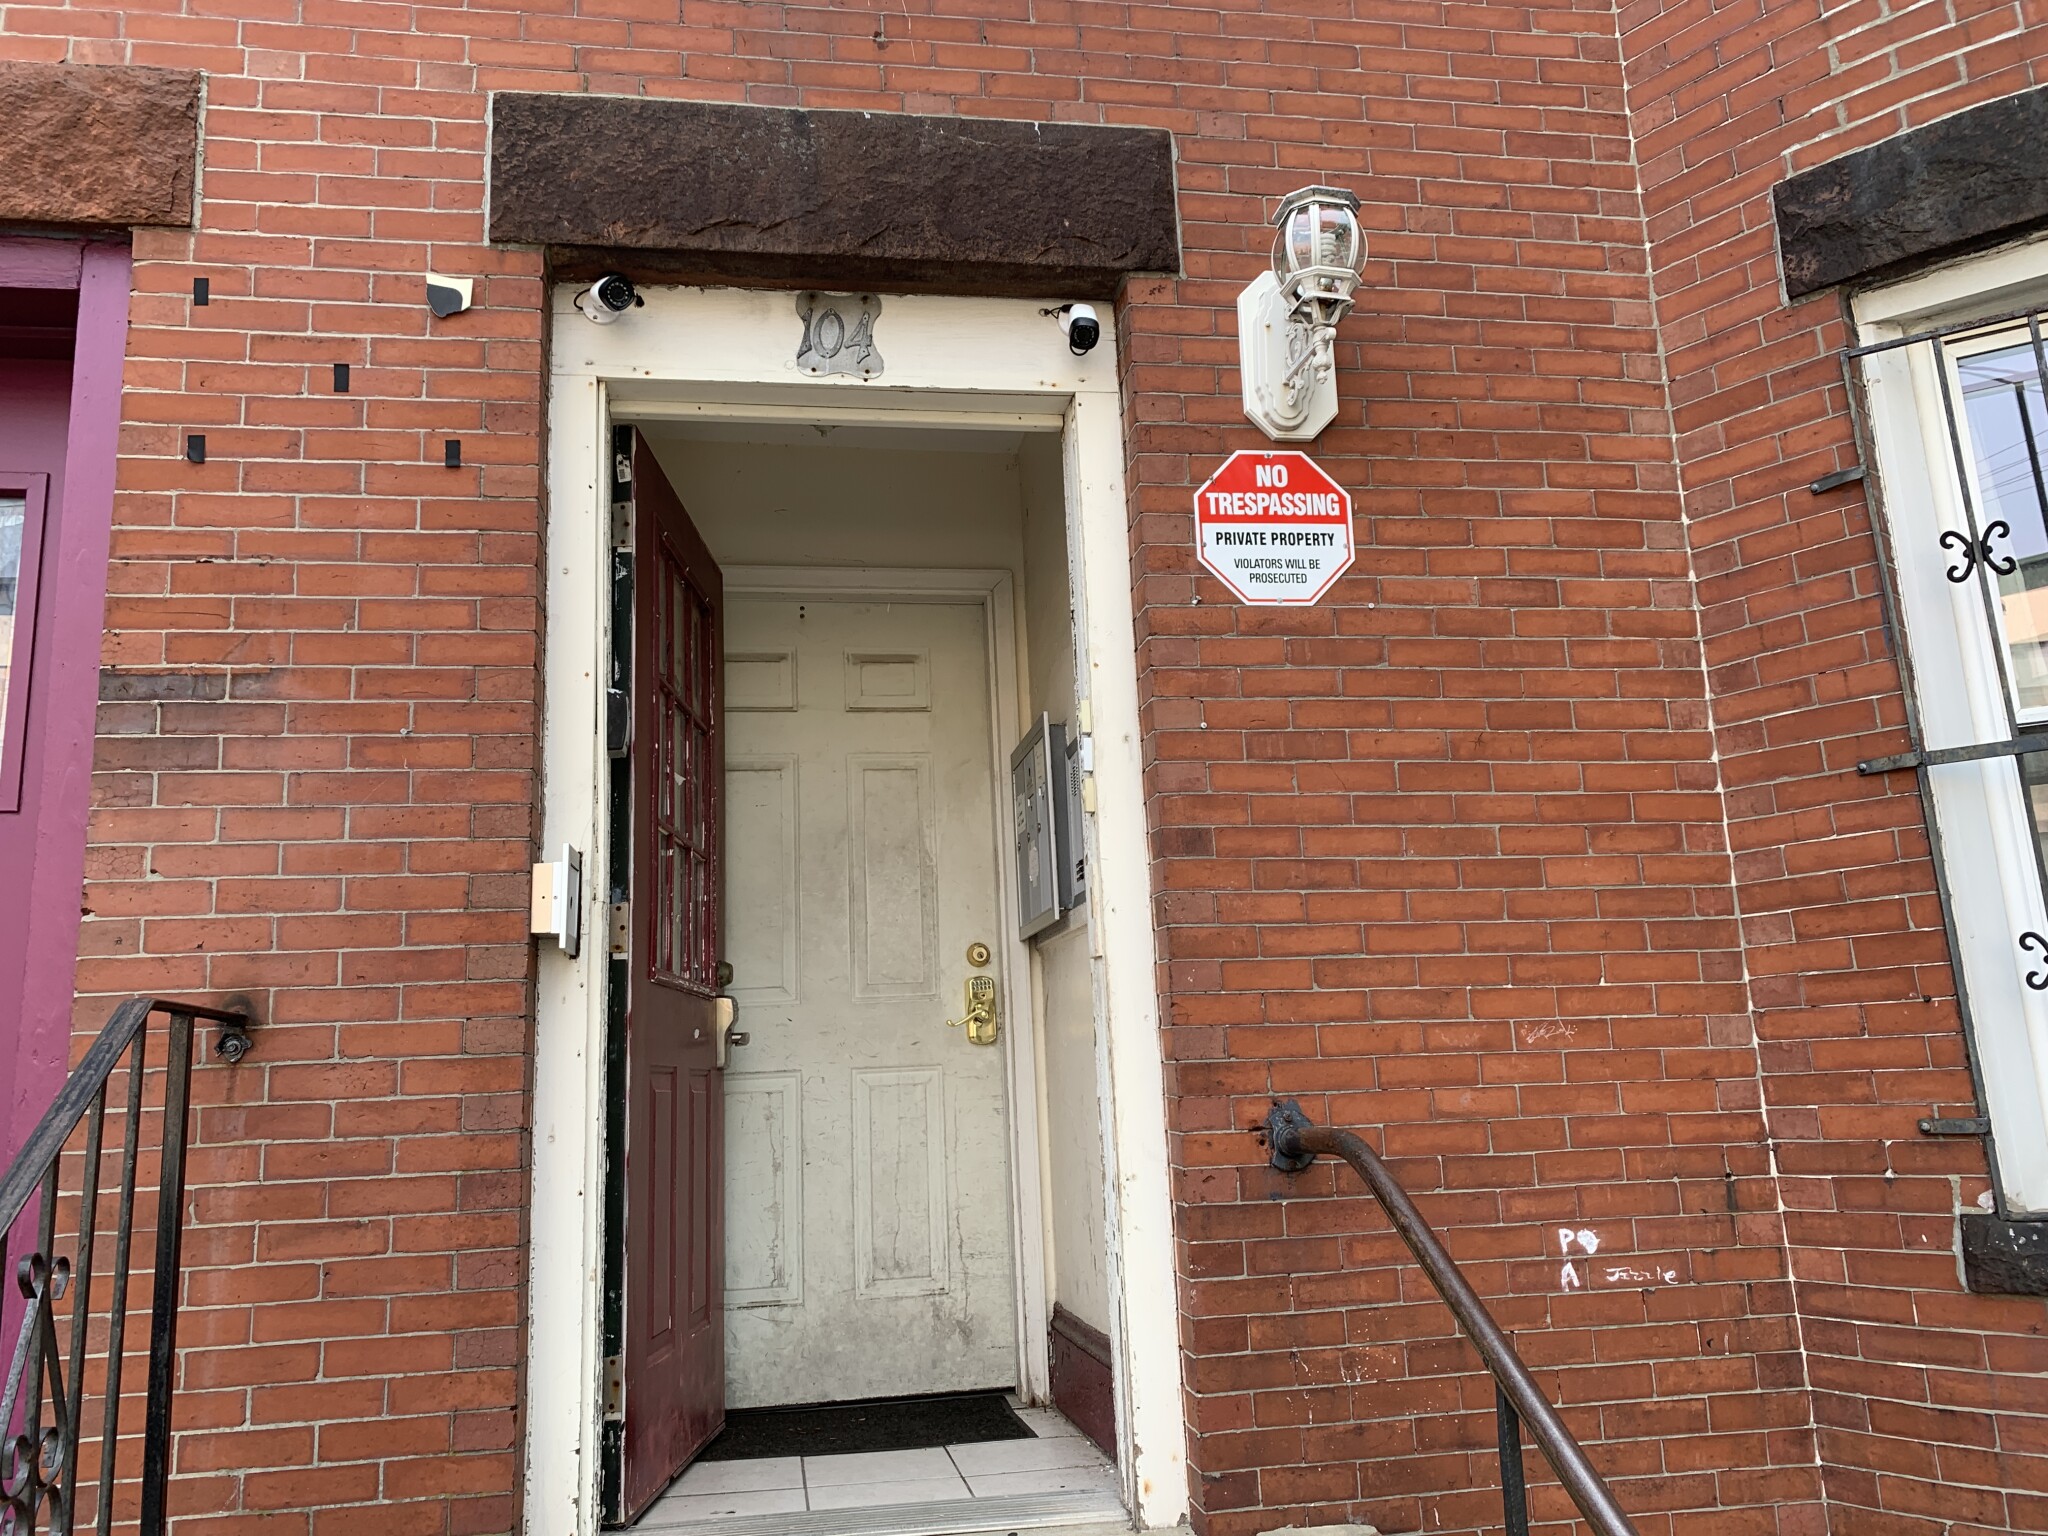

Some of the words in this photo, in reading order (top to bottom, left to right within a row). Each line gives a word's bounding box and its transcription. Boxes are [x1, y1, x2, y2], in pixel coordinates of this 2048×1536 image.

[797, 307, 873, 364] 104
[1255, 464, 1289, 488] NO
[1205, 492, 1341, 516] TRESPASSING
[1215, 532, 1267, 546] PRIVATE
[1271, 532, 1335, 547] PROPERTY
[1233, 558, 1283, 569] VIOLATORS
[1285, 559, 1307, 570] WILL
[1309, 559, 1321, 570] BE
[1249, 573, 1308, 584] PROSECUTED
